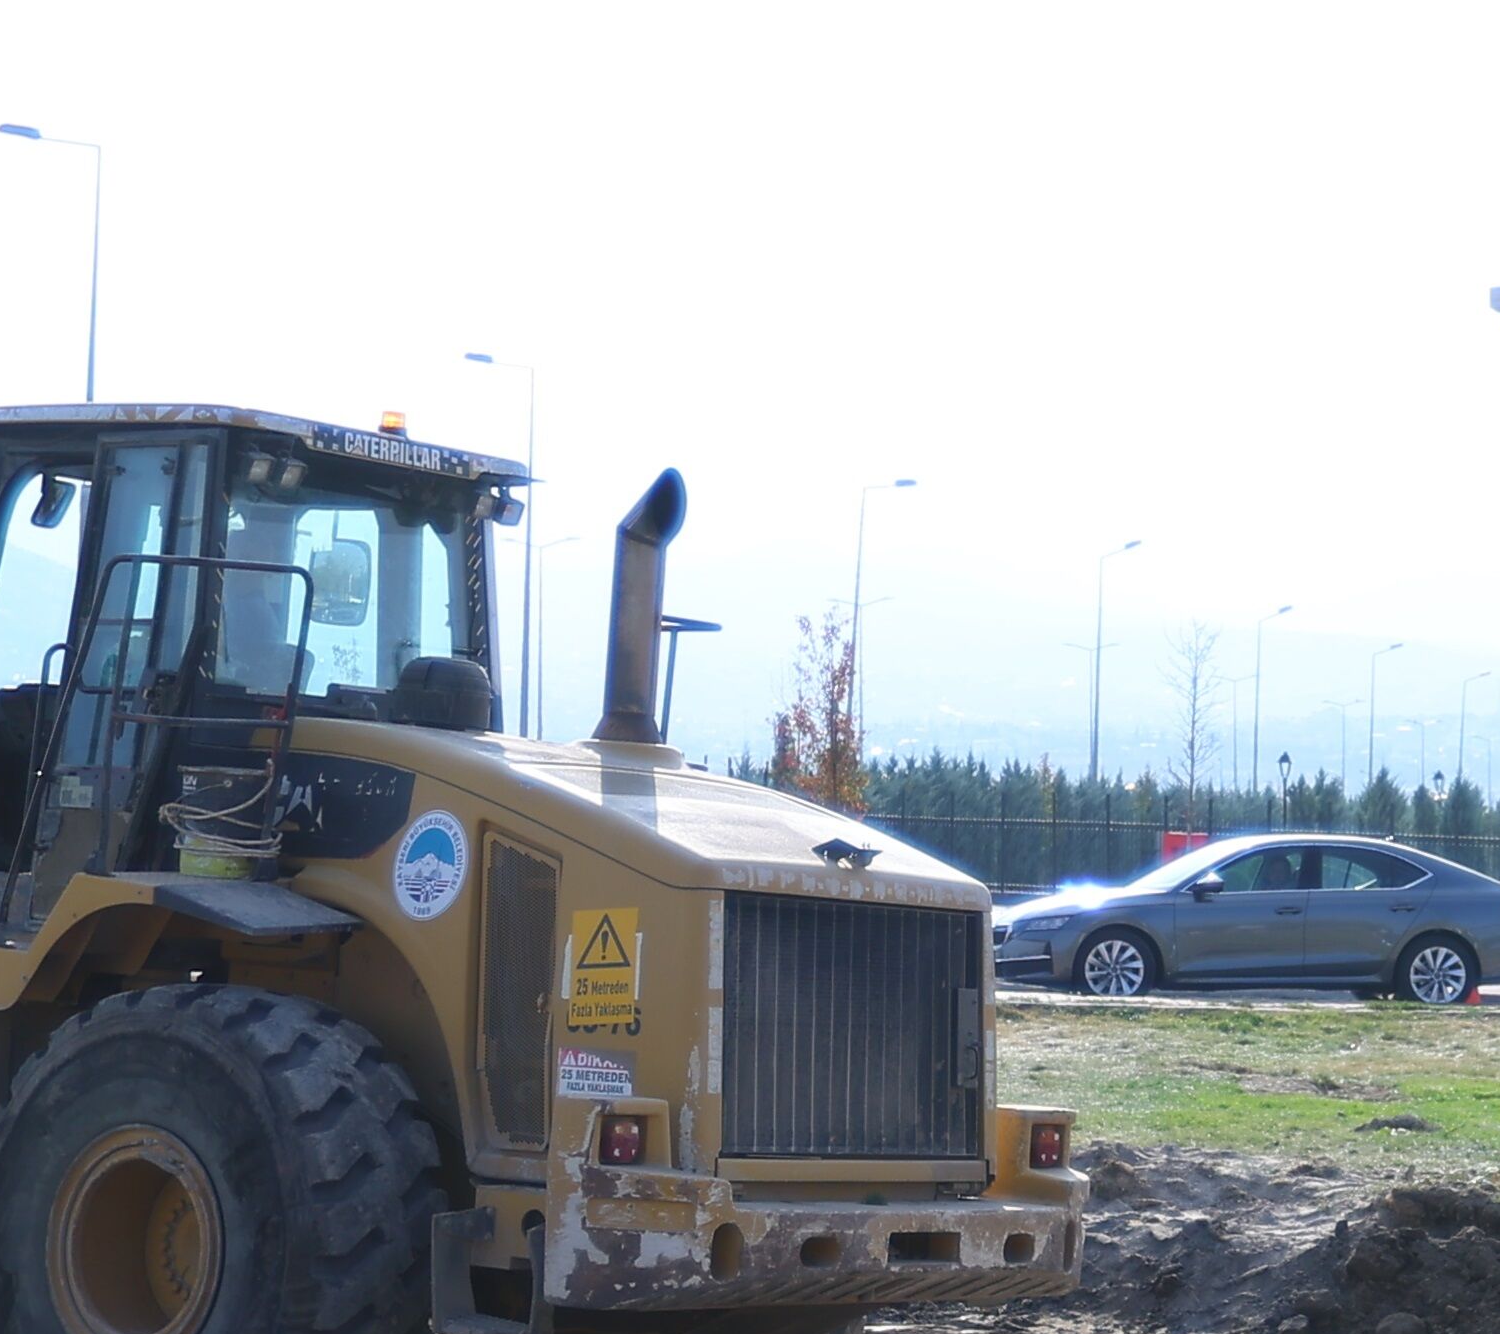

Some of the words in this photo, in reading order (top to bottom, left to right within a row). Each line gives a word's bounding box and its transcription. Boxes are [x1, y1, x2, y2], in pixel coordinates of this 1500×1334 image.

[344, 432, 441, 471] CATERPILLAR
[576, 978, 588, 996] 25
[591, 980, 629, 996] Metreden
[572, 1003, 592, 1017] Fazla
[561, 1068, 573, 1080] 25
[567, 1082, 585, 1091] FAZLA
